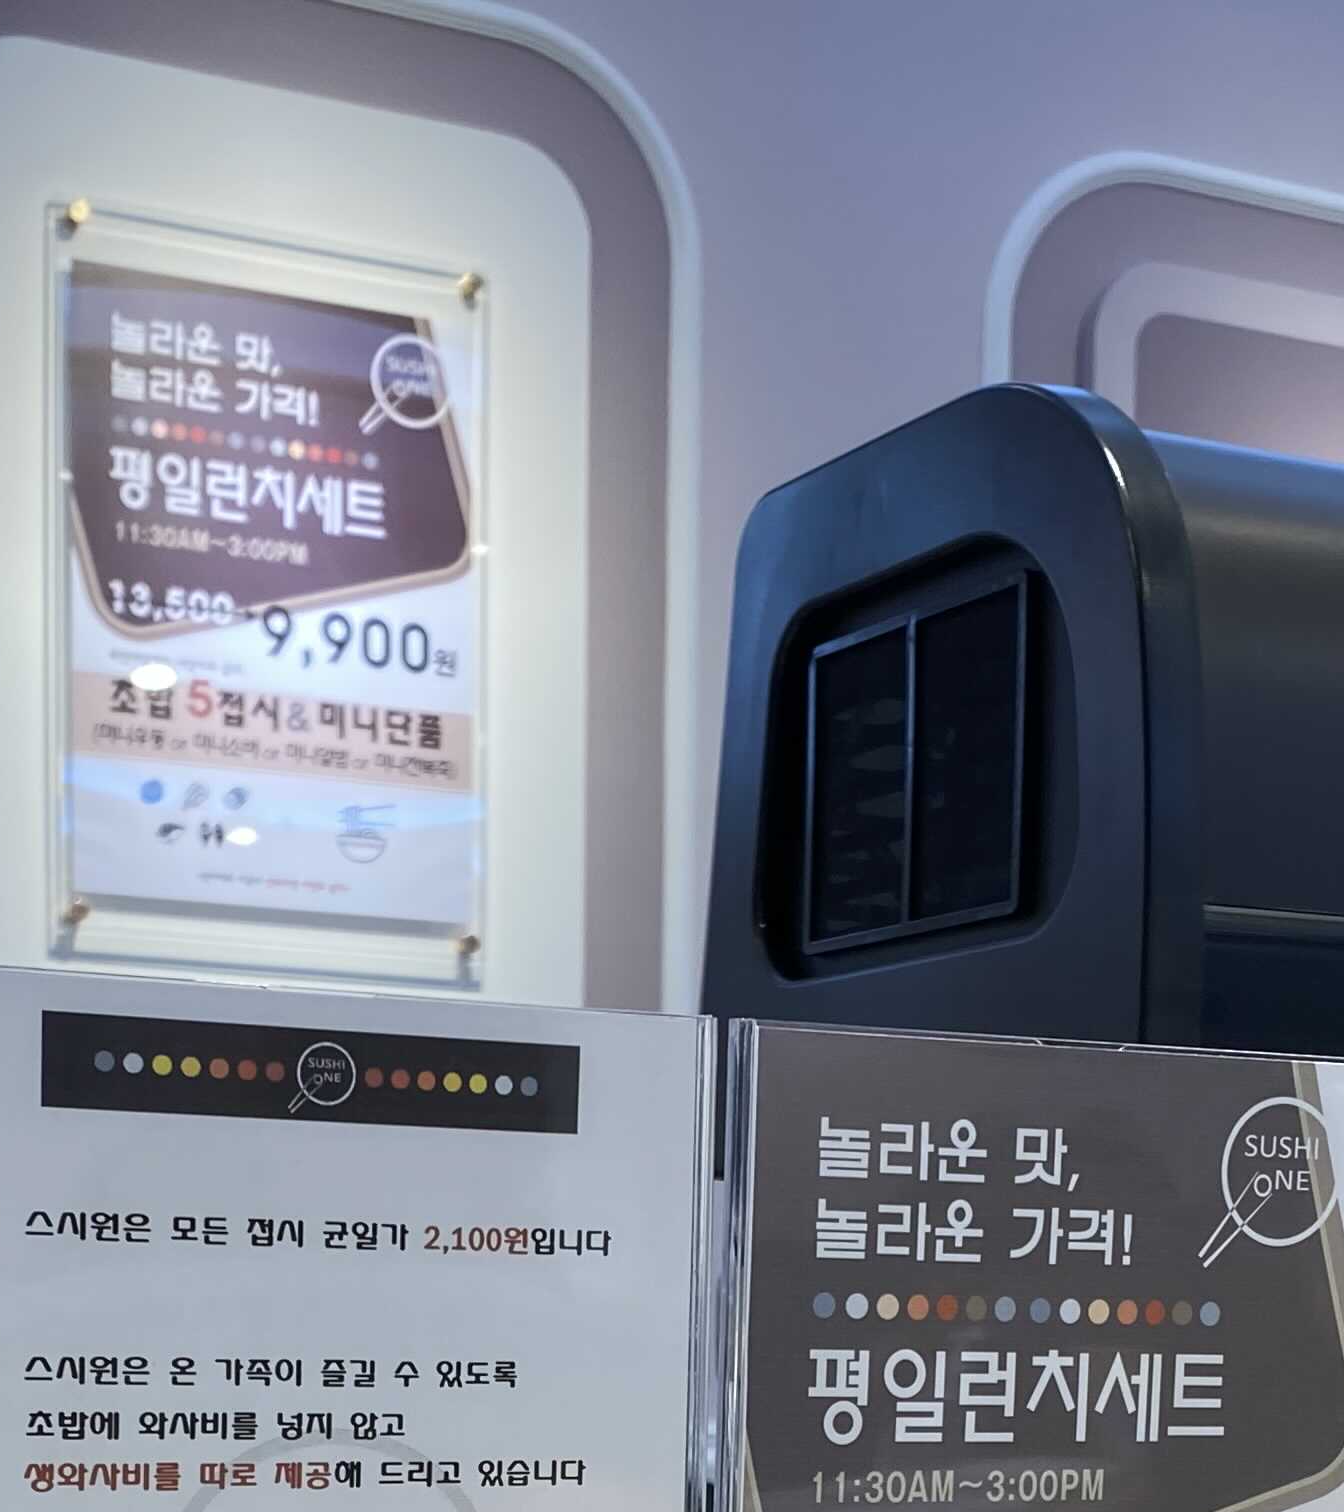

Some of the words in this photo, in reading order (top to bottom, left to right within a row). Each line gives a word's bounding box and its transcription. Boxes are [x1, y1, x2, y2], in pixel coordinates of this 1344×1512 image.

[110, 311, 222, 366] 놀라운
[234, 331, 280, 376] 맛,
[110, 358, 223, 413] 놀라운
[235, 379, 319, 427] 가격!
[108, 445, 387, 540] 평일런치세트
[307, 1056, 346, 1071] SUSHI
[314, 1072, 342, 1086] ONE
[818, 1116, 988, 1184] 놀라운
[1014, 1127, 1080, 1192] 맛,
[1243, 1134, 1321, 1161] SUSHI
[1254, 1169, 1310, 1197] ONE
[24, 1210, 152, 1243] 스시원은
[170, 1216, 229, 1246] 모든
[246, 1218, 304, 1249] 접시
[322, 1220, 410, 1252] 균일가
[423, 1225, 612, 1257] 2,100원입니다
[815, 1197, 984, 1263] 놀라운
[1009, 1207, 1133, 1266] 가격!
[23, 1356, 151, 1386] 스시원은
[169, 1356, 197, 1387] 온
[214, 1357, 302, 1388] 가족이
[320, 1358, 376, 1388] 즐길
[393, 1360, 420, 1388] 수
[435, 1360, 518, 1389] 있도록
[807, 1348, 1225, 1446] 평일런치세트
[25, 1410, 120, 1441] 초밥에
[138, 1411, 259, 1441] 와사비를
[351, 1410, 405, 1440] 않고
[23, 1462, 182, 1494] 생와사비를
[199, 1459, 256, 1490] 따로
[274, 1460, 362, 1490] 제공해
[378, 1460, 462, 1488] 드리고
[477, 1459, 587, 1488] 있습니다
[812, 1468, 1105, 1504] 11:30AM~3:00PM
